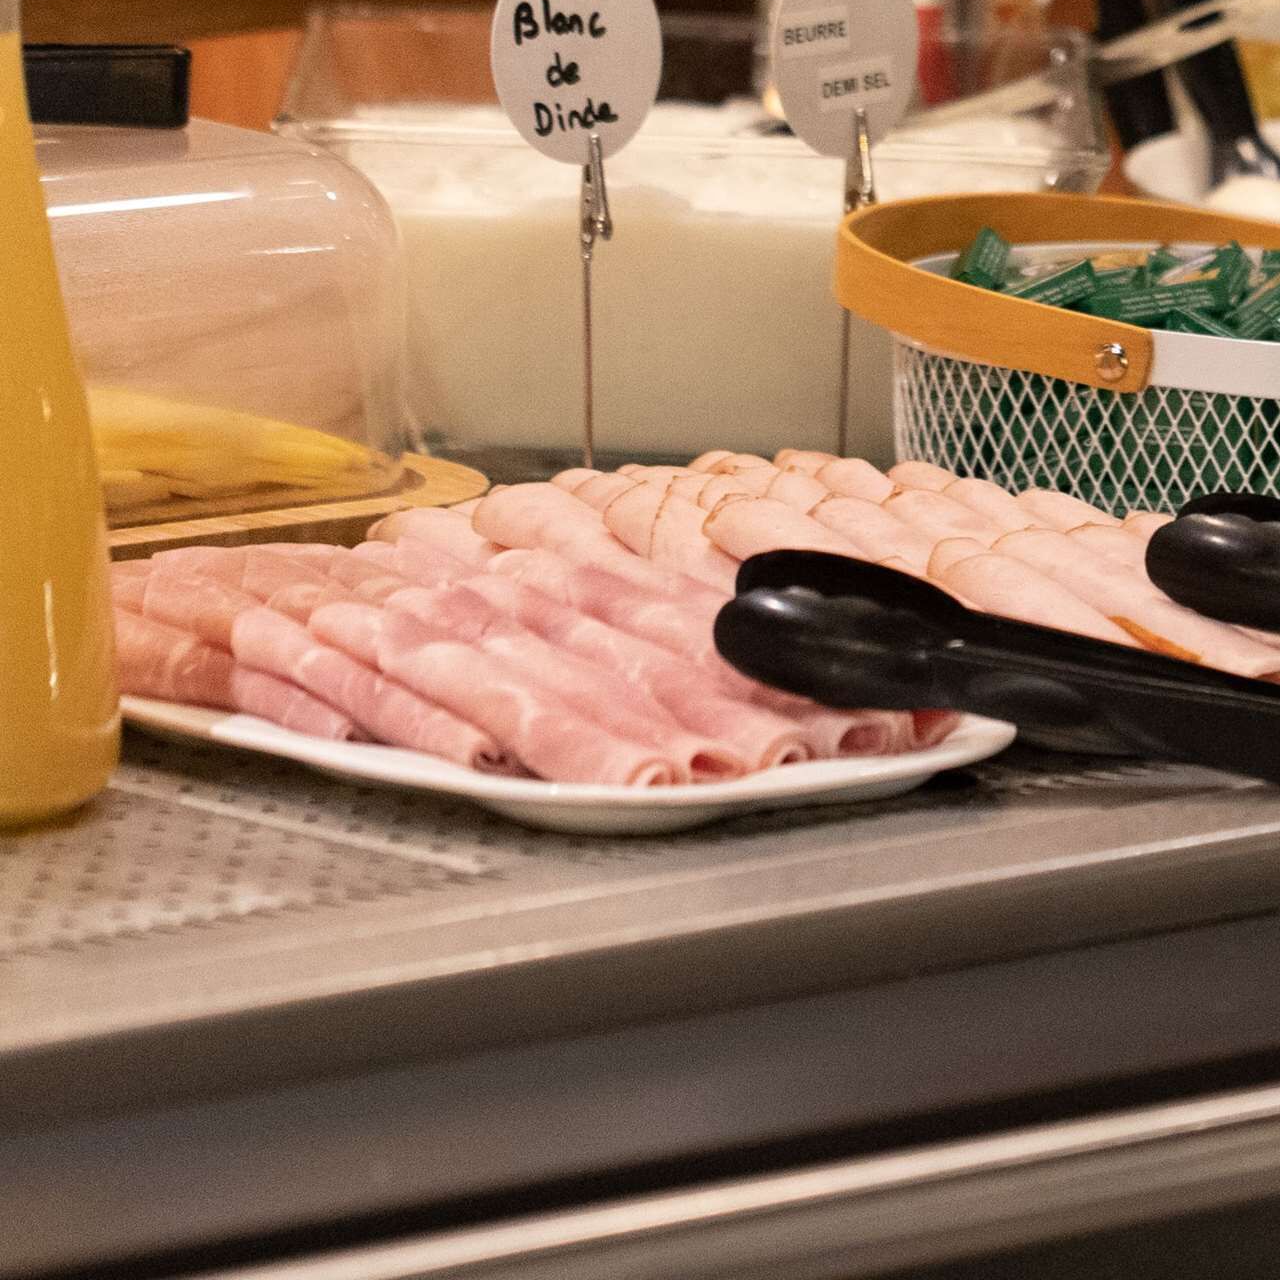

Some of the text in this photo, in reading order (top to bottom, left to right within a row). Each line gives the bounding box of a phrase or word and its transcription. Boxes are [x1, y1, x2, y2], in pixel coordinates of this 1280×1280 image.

[783, 21, 846, 46] BEURRE
[546, 52, 581, 87] de
[822, 72, 890, 99] DEMI SEL
[534, 98, 619, 136] Dinde
